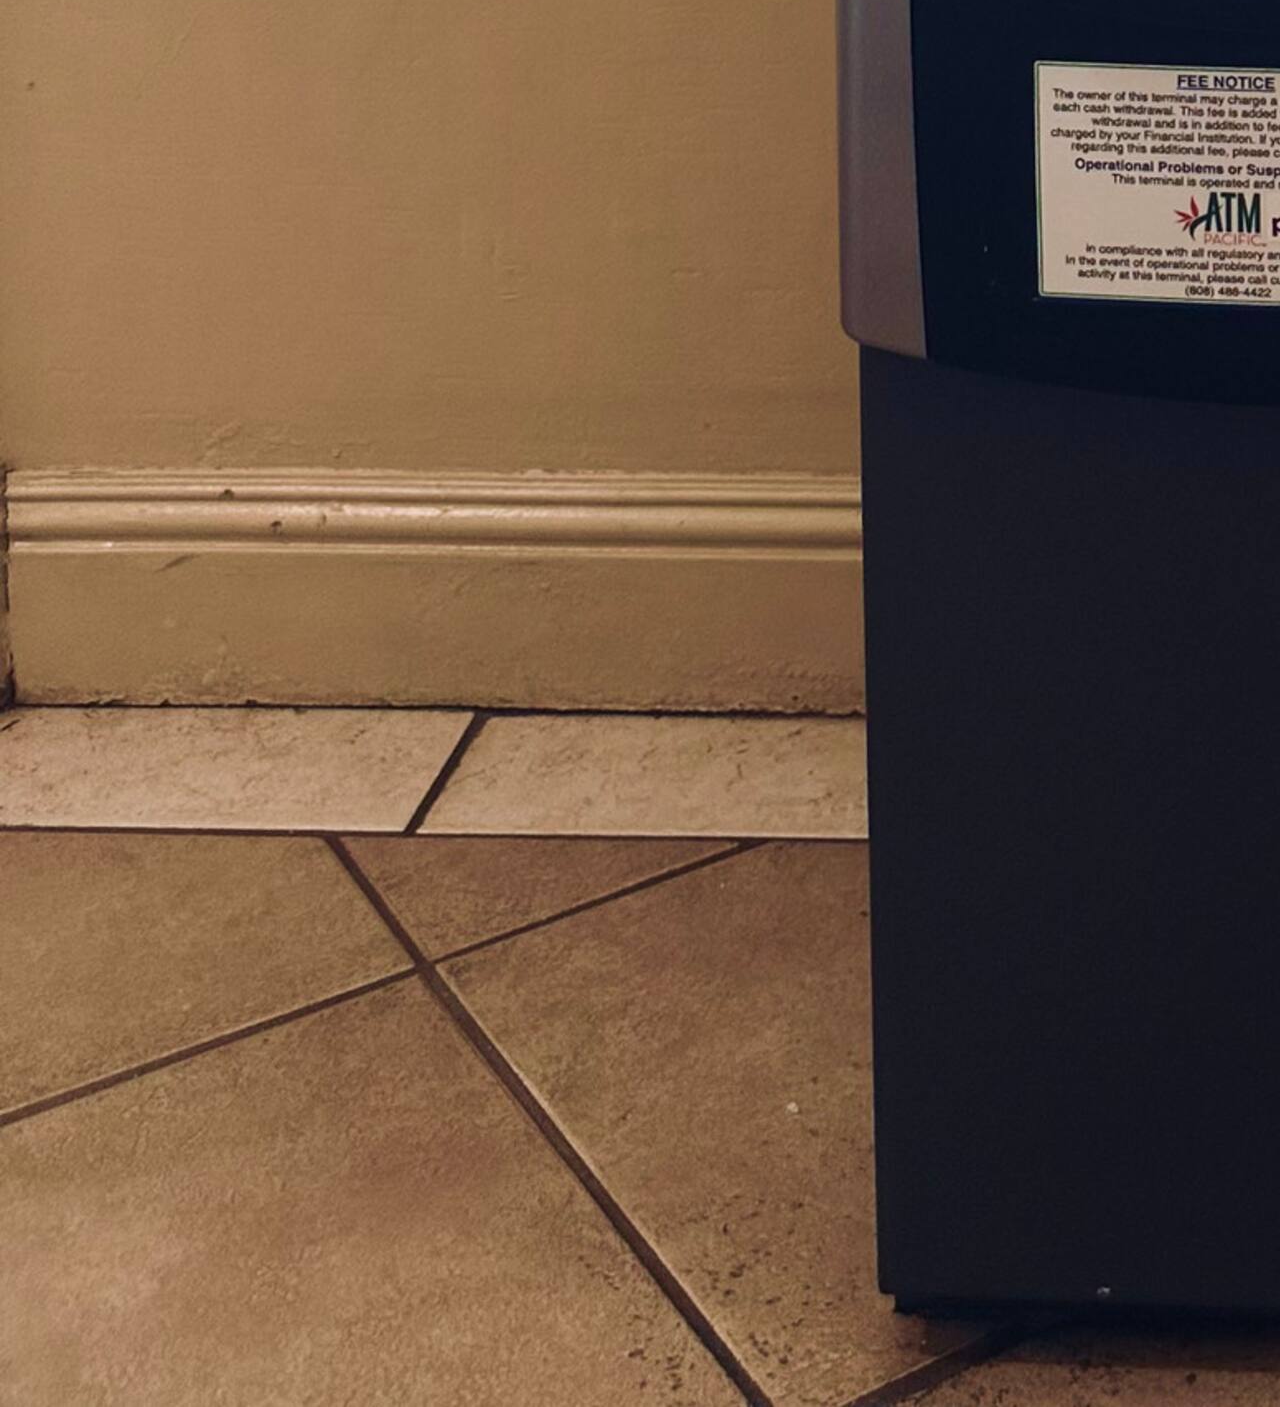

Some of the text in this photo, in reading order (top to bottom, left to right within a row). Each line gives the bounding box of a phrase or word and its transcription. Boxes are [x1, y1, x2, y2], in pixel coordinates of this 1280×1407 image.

[1177, 75, 1275, 91] FEE NOTICE
[1053, 88, 1074, 99] The
[1077, 91, 1111, 101] owner
[1114, 90, 1126, 101] of
[1128, 91, 1148, 102] this
[1151, 92, 1197, 104] terminal
[1200, 95, 1224, 106] may
[1227, 96, 1266, 107] charge
[1270, 98, 1277, 106] a
[1053, 102, 1080, 112] each
[1083, 103, 1110, 113] cash
[1113, 104, 1175, 116] withdrawal.
[1179, 106, 1204, 117] This
[1207, 107, 1225, 117] fee
[1228, 108, 1238, 118] is
[1241, 108, 1277, 119] added
[1091, 117, 1151, 128] withdrawal
[1154, 118, 1175, 129] and
[1178, 119, 1188, 129] is
[1191, 119, 1202, 129] in
[1205, 120, 1250, 131] addition
[1252, 121, 1264, 131] to
[1050, 127, 1096, 140] charged
[1099, 128, 1113, 140] by
[1115, 131, 1140, 142] your
[1143, 130, 1194, 142] Financial
[1198, 132, 1253, 144] Institution.
[1259, 134, 1267, 144] If
[1070, 142, 1123, 154] regarding
[1126, 142, 1147, 153] this
[1150, 143, 1204, 155] additional
[1207, 145, 1229, 157] fee,
[1232, 148, 1270, 159] please
[1075, 157, 1154, 173] Operational
[1158, 161, 1224, 174] Problems
[1227, 165, 1243, 175] or
[1112, 173, 1136, 184] This
[1139, 175, 1185, 186] terminal
[1187, 176, 1197, 186] is
[1199, 177, 1249, 189] operated
[1253, 179, 1275, 189] and
[1204, 192, 1261, 233] ATM
[1204, 233, 1262, 247] PACIFIC
[1099, 244, 1162, 257] compliance
[1165, 247, 1188, 257] with
[1191, 248, 1204, 258] all
[1207, 248, 1264, 261] regulatory
[1066, 254, 1076, 265] In
[1079, 255, 1096, 266] the
[1099, 257, 1130, 267] event
[1133, 257, 1144, 268] of
[1147, 258, 1209, 271] operational
[1212, 260, 1265, 272] problems
[1268, 264, 1279, 273] or
[1077, 269, 1116, 281] activity
[1119, 270, 1130, 280] at
[1132, 270, 1152, 280] this
[1207, 274, 1245, 285] please
[1247, 275, 1267, 285] call
